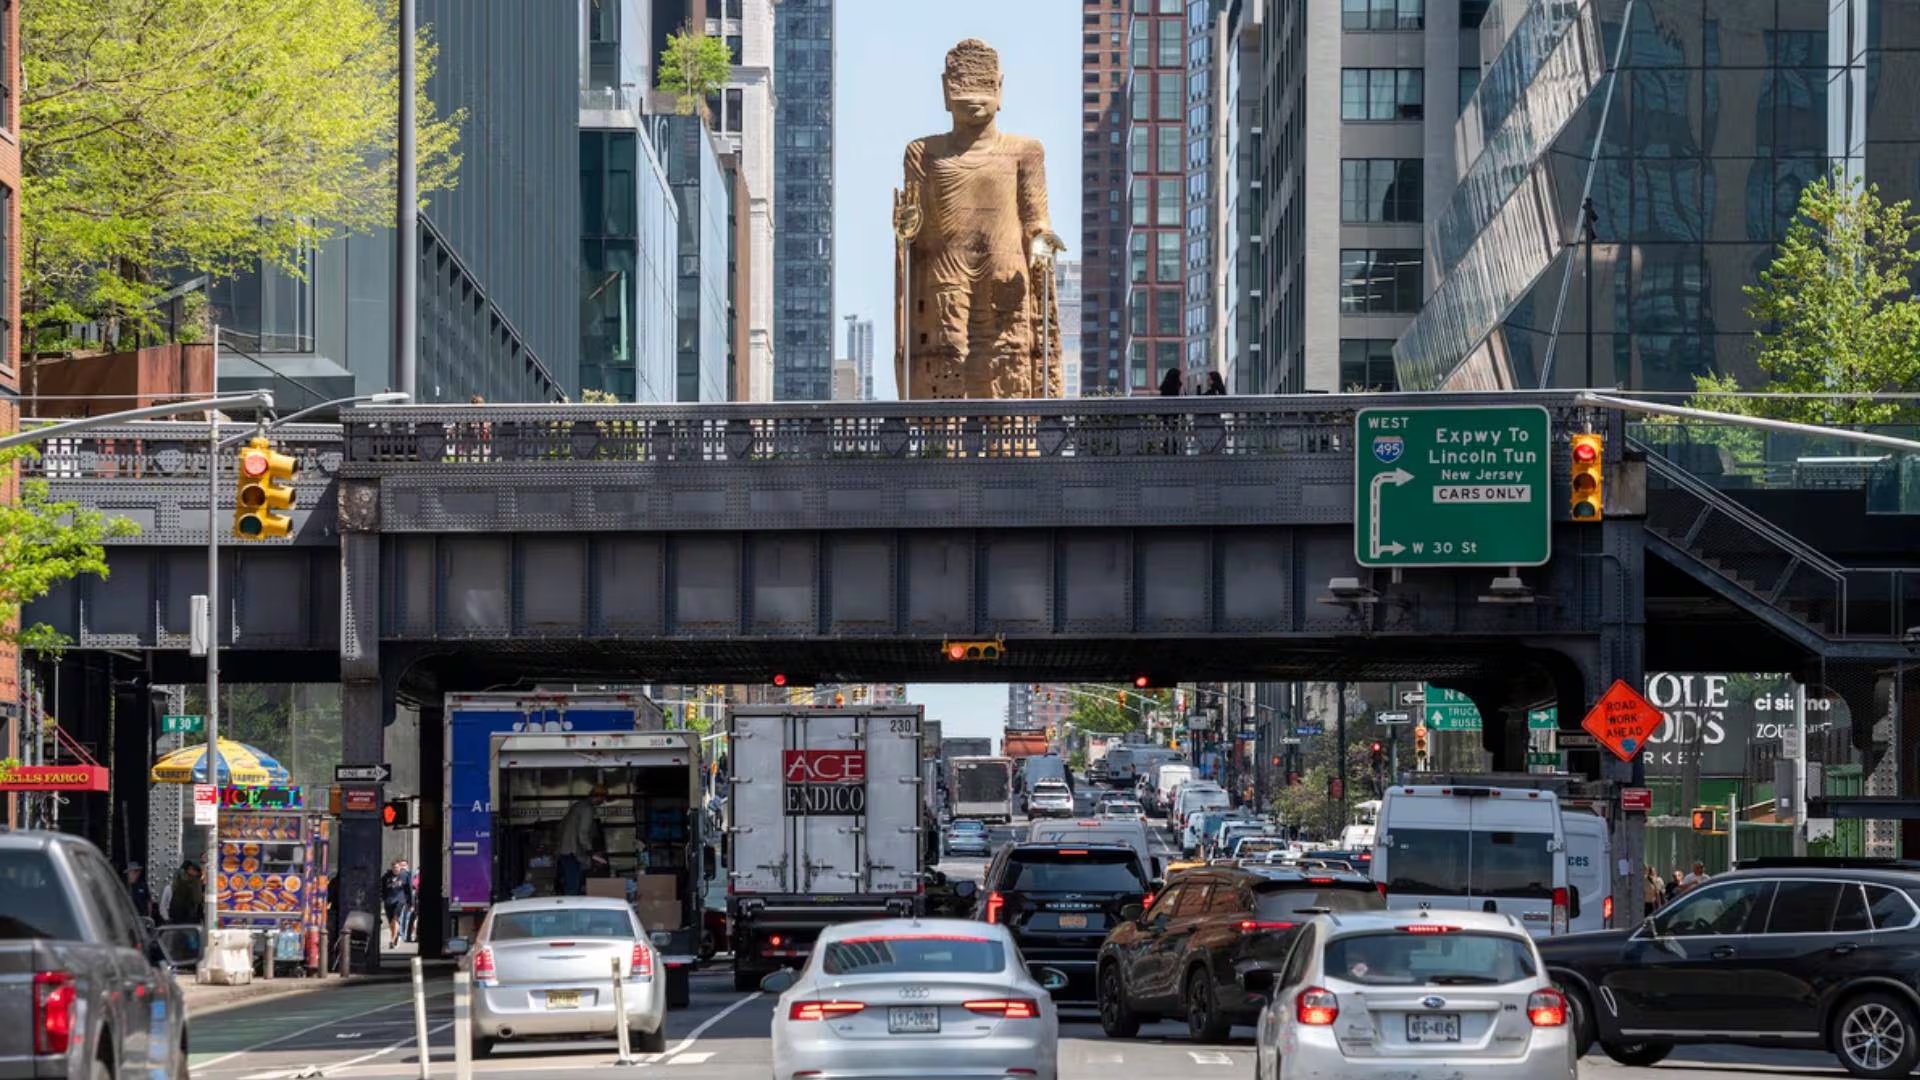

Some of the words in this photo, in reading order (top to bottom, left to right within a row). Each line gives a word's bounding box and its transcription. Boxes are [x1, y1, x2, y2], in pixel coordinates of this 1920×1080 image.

[1368, 417, 1409, 429] WEST
[1436, 428, 1501, 446] Expwy
[1508, 427, 1529, 442] To
[1376, 443, 1400, 456] 495
[1429, 449, 1497, 464] Lincoln
[1504, 448, 1537, 463] Tun
[1441, 468, 1471, 480] New
[1476, 468, 1523, 482] Jersey
[1438, 488, 1481, 500] CARS
[1485, 487, 1526, 499] ONLY
[1412, 541, 1424, 554] W
[1432, 541, 1454, 554] 30
[1461, 541, 1477, 553] St
[1644, 672, 1729, 708] OLE
[1606, 700, 1637, 711] ROAD
[1754, 692, 1772, 711] ci
[168, 717, 176, 730] W
[179, 717, 192, 730] 30
[1609, 713, 1638, 724] WORK
[889, 719, 912, 733] 230
[1606, 727, 1643, 738] AHEAD
[1648, 711, 1726, 745] ODS
[786, 754, 864, 779] ACE
[44, 772, 89, 784] FARGO
[786, 785, 865, 812] ENDICO
